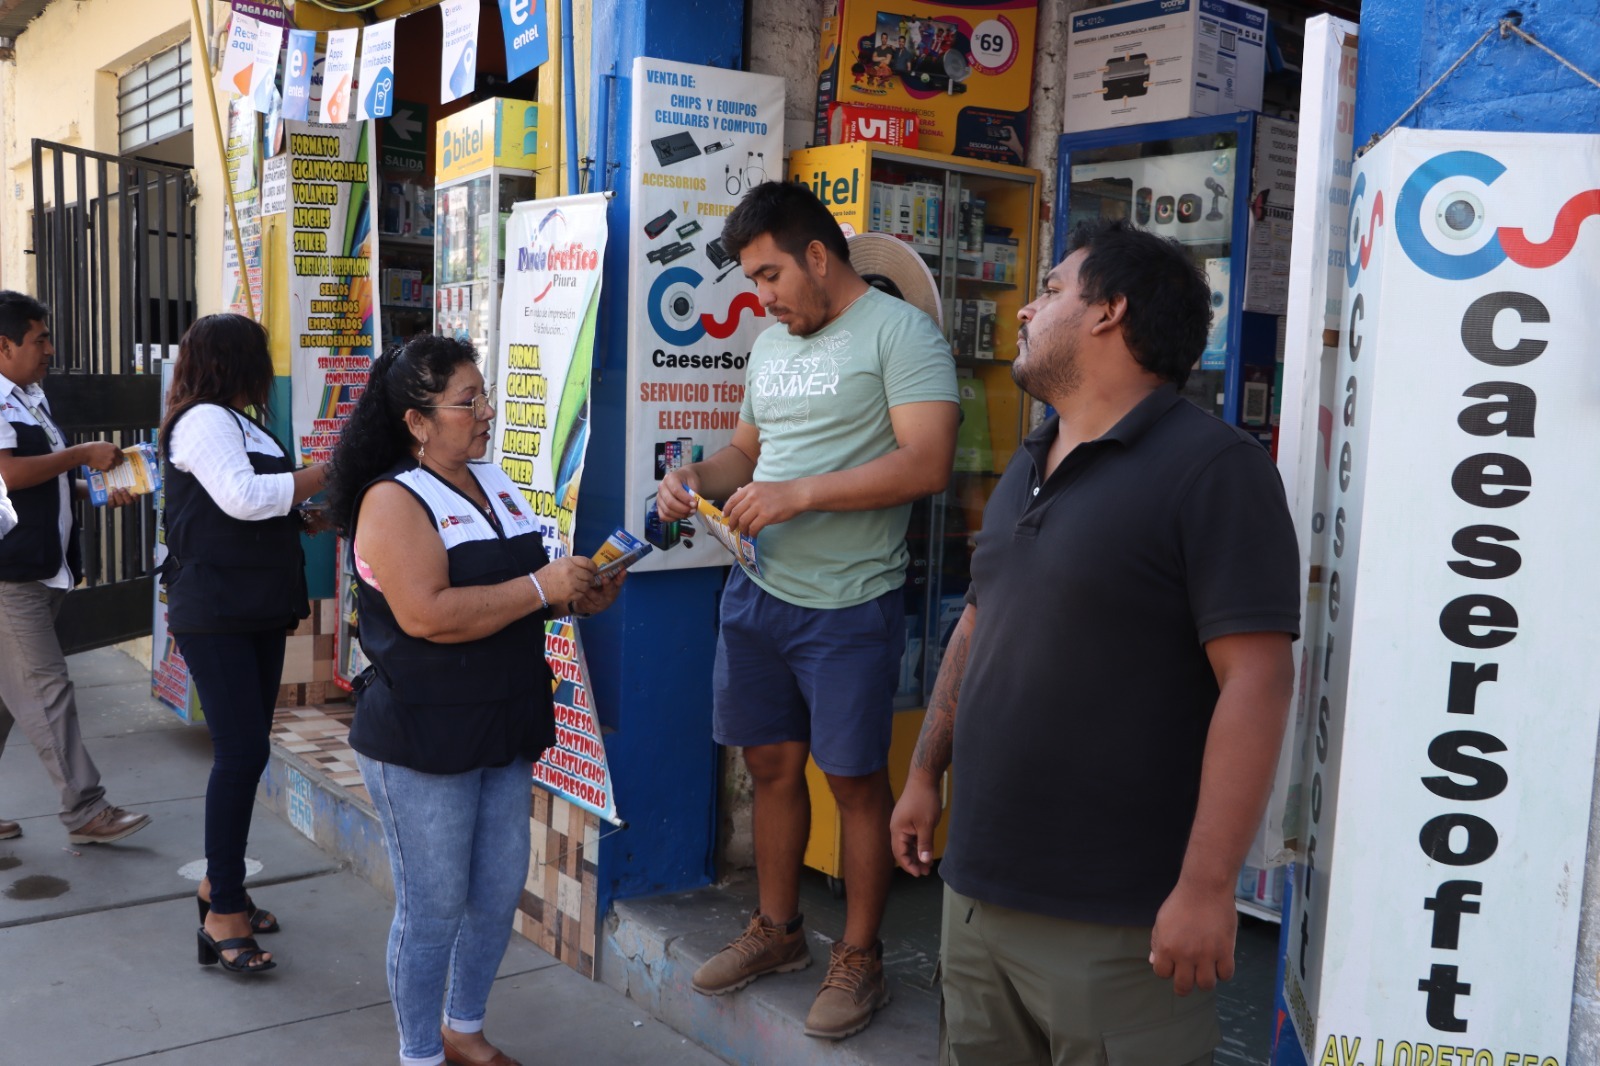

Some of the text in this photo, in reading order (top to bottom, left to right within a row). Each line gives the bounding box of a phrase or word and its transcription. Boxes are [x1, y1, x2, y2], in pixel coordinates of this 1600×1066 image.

[235, 2, 261, 15] PAGA
[513, 24, 539, 50] entel
[980, 33, 1004, 53] 69
[329, 49, 343, 61] Apps
[646, 69, 696, 89] VENTA DE:
[288, 84, 304, 97] entel
[670, 93, 758, 118] CHIPS Y EQUIPOS
[655, 109, 768, 136] CELULARES Y COMPUTO
[888, 117, 896, 146] ILIMIT
[290, 133, 340, 158] FORMATOS
[453, 119, 484, 162] bitel
[384, 154, 424, 171] SALIDA
[1268, 153, 1293, 166] PROBADO
[291, 157, 368, 183] GIGANTOGRAFIAS
[642, 172, 707, 192] ACCESORIOS
[292, 182, 339, 206] VOLANTES
[682, 200, 689, 215] Y
[293, 207, 331, 229] AFICHES
[293, 231, 327, 253] STIKER
[547, 241, 599, 272] Gráfico
[320, 282, 349, 297] SELLOS
[553, 273, 577, 288] Piura
[310, 300, 360, 314] ENMICADOS
[548, 308, 576, 321] impresión
[308, 317, 363, 331] EMPASTADOS
[300, 333, 373, 348] ENCUADERNADOS
[317, 356, 345, 370] SERVICIO
[758, 355, 821, 376] ENDLESS
[640, 379, 746, 403] SERVICIO TÉCN
[755, 372, 839, 398] SUMMER
[313, 419, 341, 432] SISTEMAS
[301, 434, 332, 449] RECARGAS
[502, 428, 541, 456] AFICHES
[311, 450, 331, 464] TONER
[501, 455, 534, 486] STIKER
[541, 524, 555, 539] DE
[546, 634, 570, 656] ICIO
[547, 746, 607, 787] CARTUCHOS
[545, 764, 607, 810] IMPRESORAS
